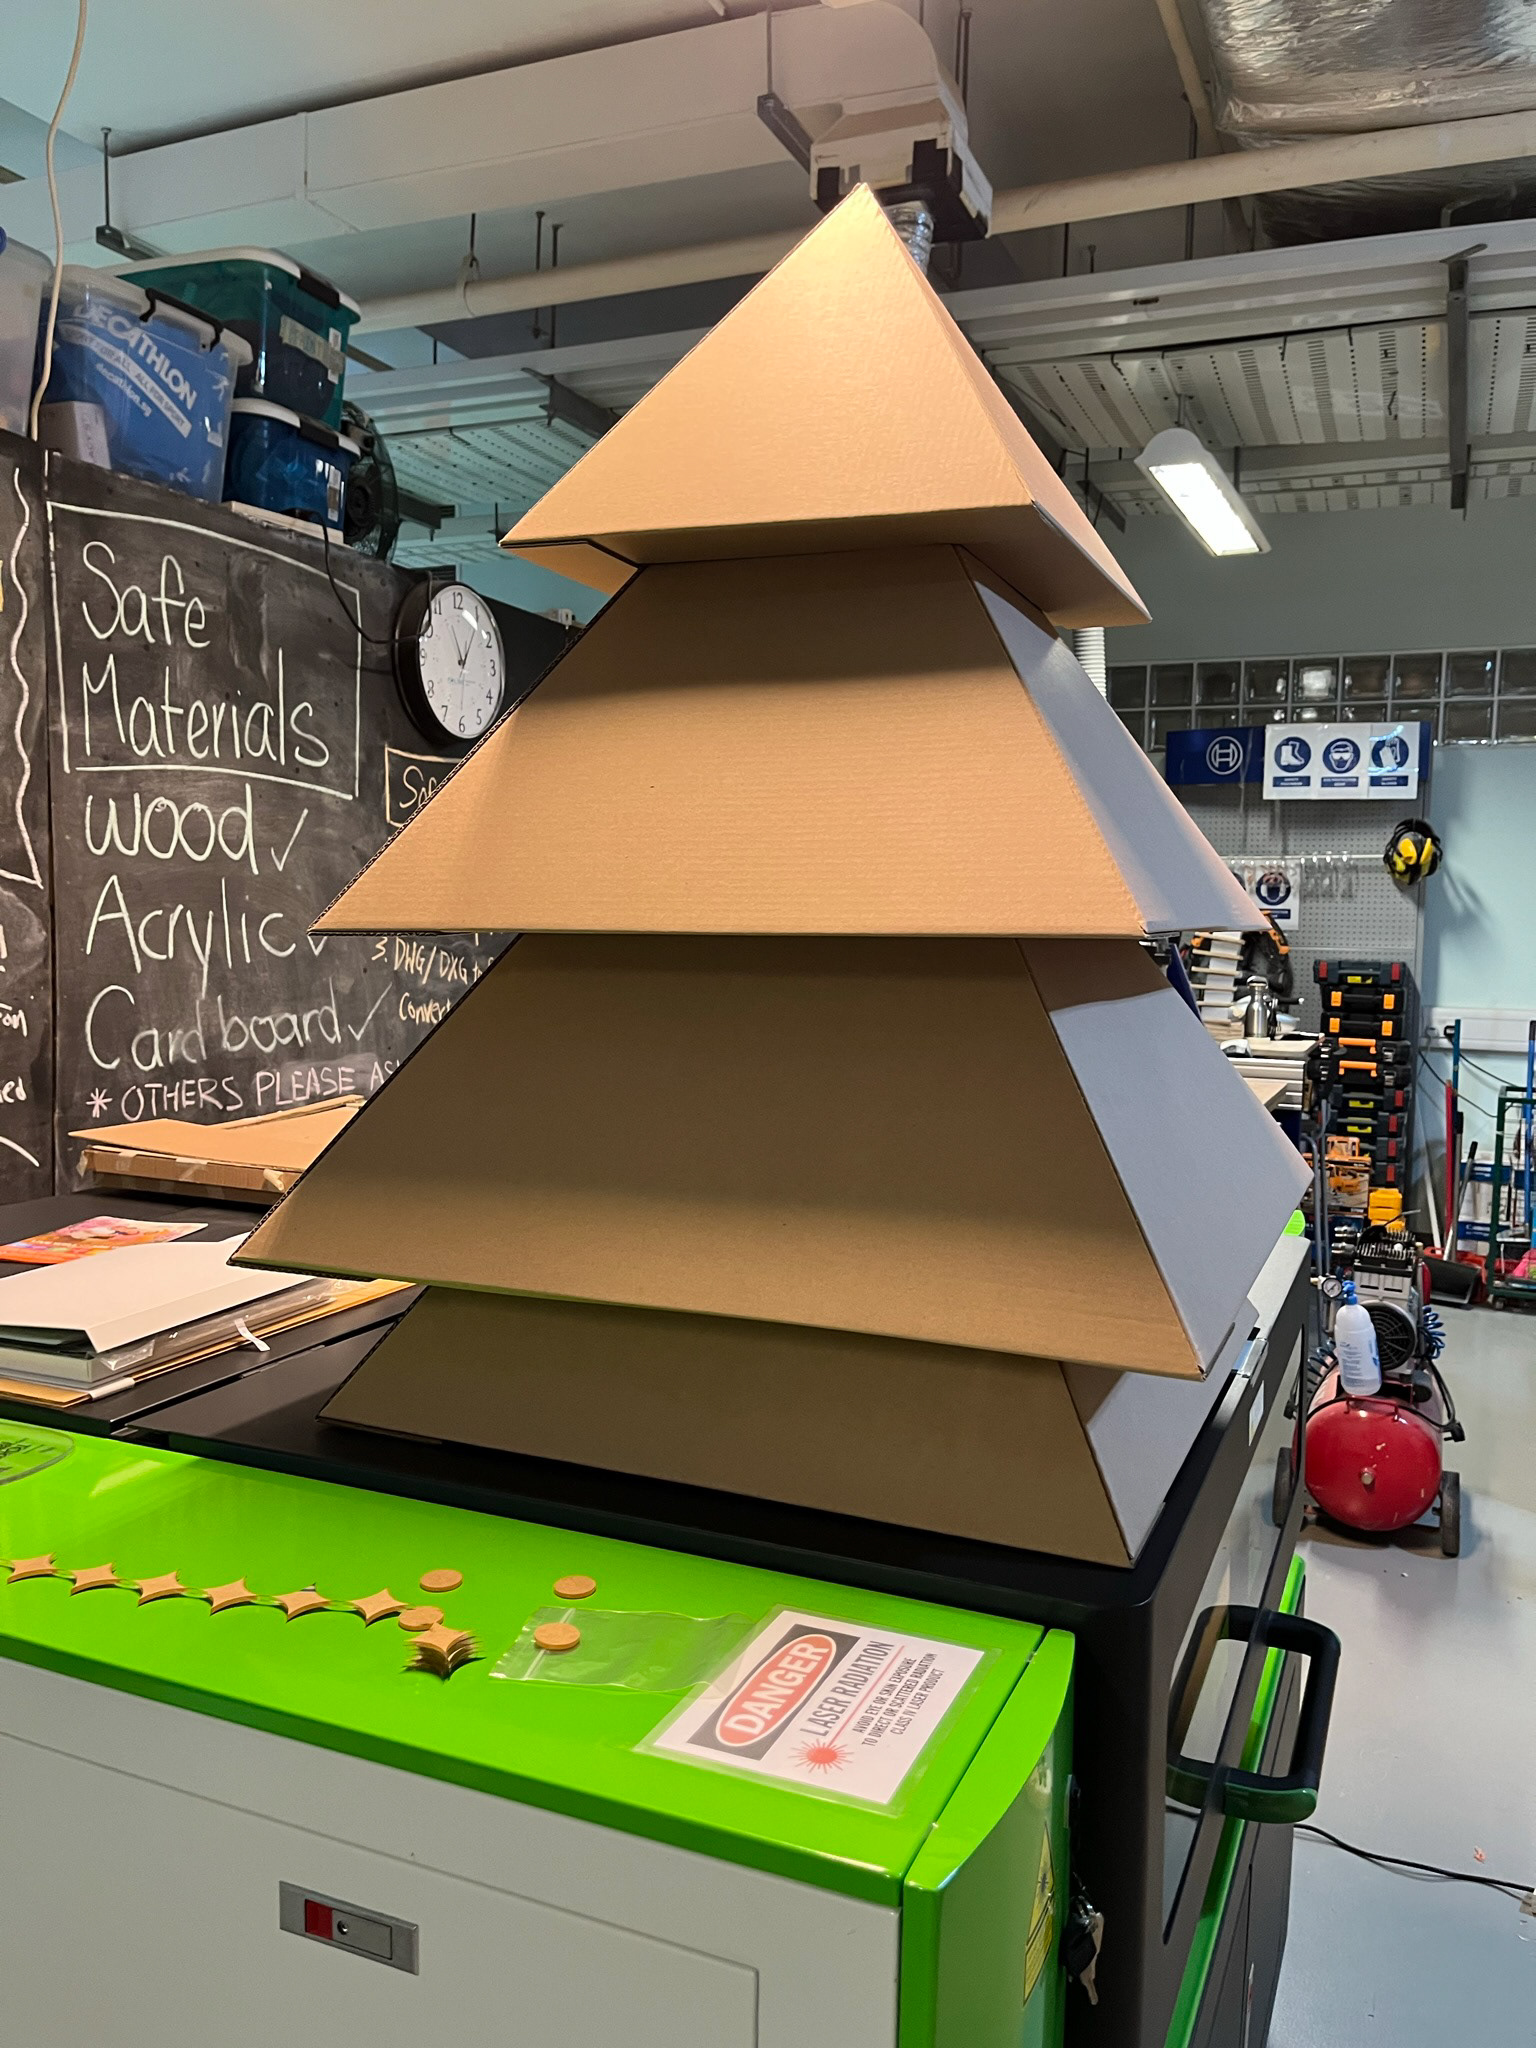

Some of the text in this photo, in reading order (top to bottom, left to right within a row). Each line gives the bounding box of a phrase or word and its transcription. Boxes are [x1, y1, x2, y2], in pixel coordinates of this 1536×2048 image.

[73, 302, 197, 411] DECATHLON
[82, 540, 211, 648] Safe
[433, 597, 443, 616] 11
[452, 591, 464, 610] 12
[485, 630, 493, 649] 2
[489, 658, 497, 677] 3
[83, 646, 330, 768] Materials
[427, 679, 435, 699] 8
[441, 704, 449, 723] 7
[475, 708, 483, 726] 5
[485, 687, 494, 705] 4
[458, 714, 466, 733] 6
[86, 874, 297, 1000] Acrylic
[121, 1076, 244, 1122] OTHERS
[255, 1066, 356, 1107] PLEASE
[725, 1642, 830, 1736] DANGER
[800, 1640, 895, 1737] LASER RADIATION
[852, 1657, 918, 1733] AVOID EYE OR SKIN EXPOSURE
[861, 1652, 938, 1747] TO DIRECT OR SCATTERED RADIATION
[890, 1668, 945, 1735] CLASS IV LASER PRODUCT
